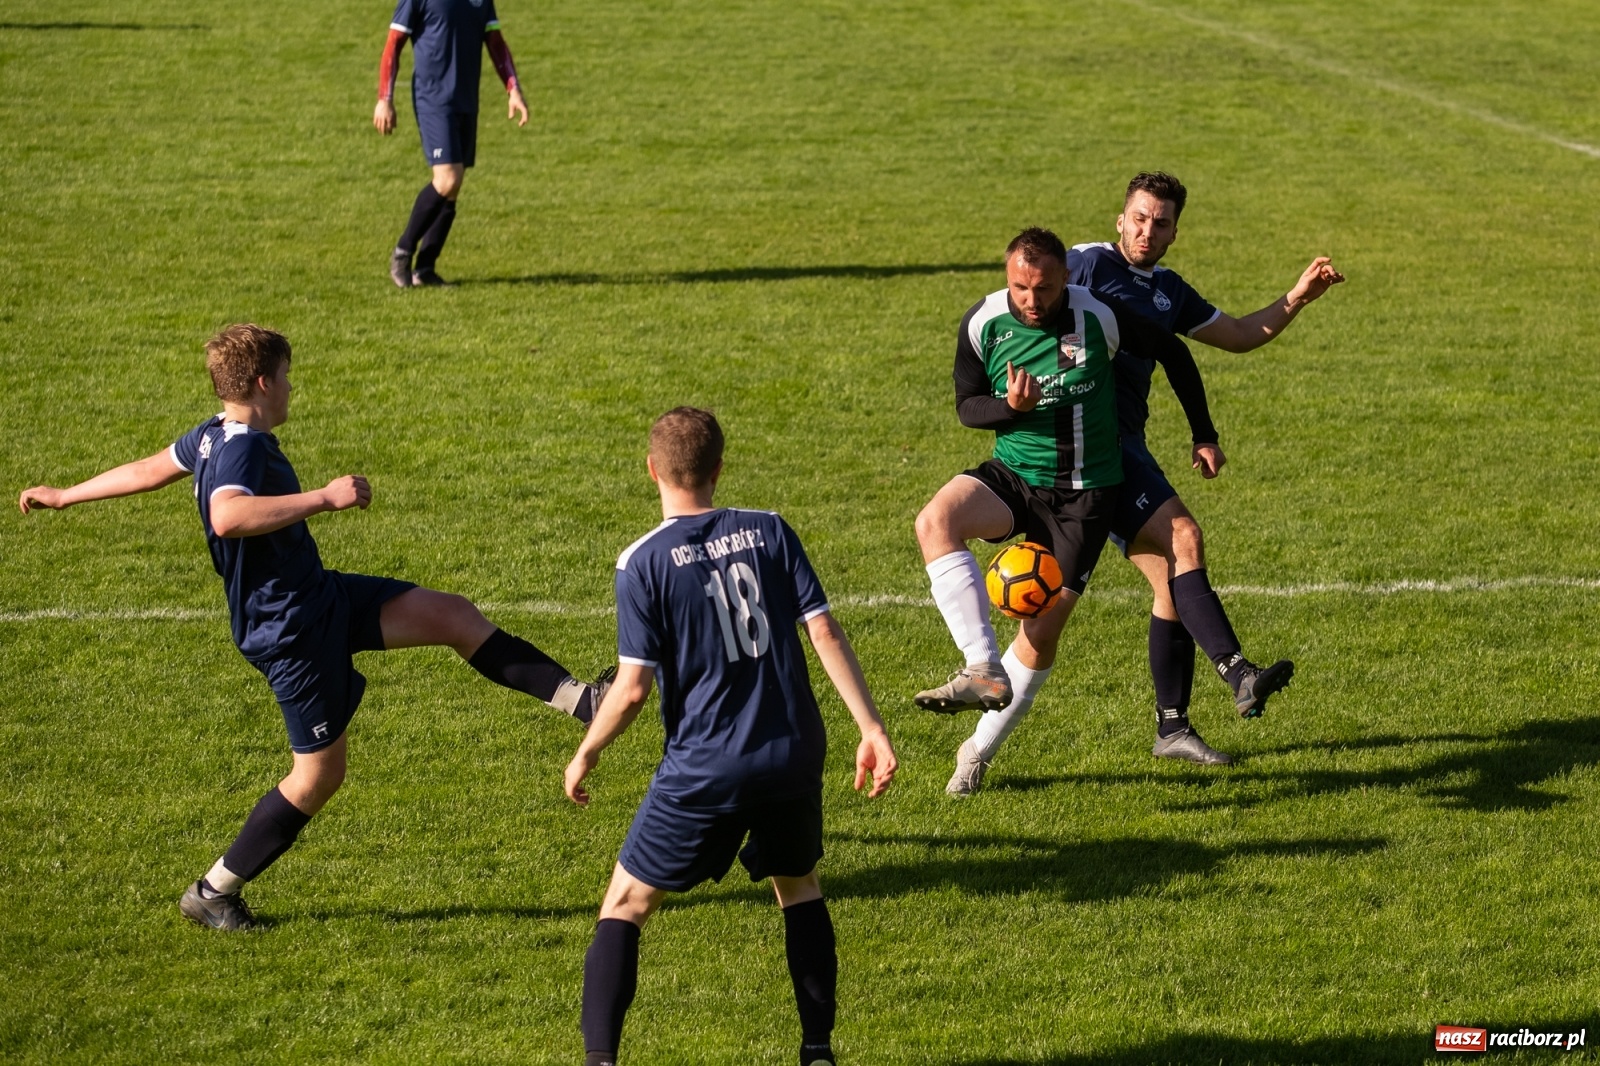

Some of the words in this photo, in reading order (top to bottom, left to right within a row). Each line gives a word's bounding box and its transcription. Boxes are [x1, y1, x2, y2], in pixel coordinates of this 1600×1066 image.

[1036, 373, 1067, 388] PORT
[1041, 387, 1066, 397] CIEL
[671, 543, 708, 567] OCICE
[704, 562, 769, 663] 18
